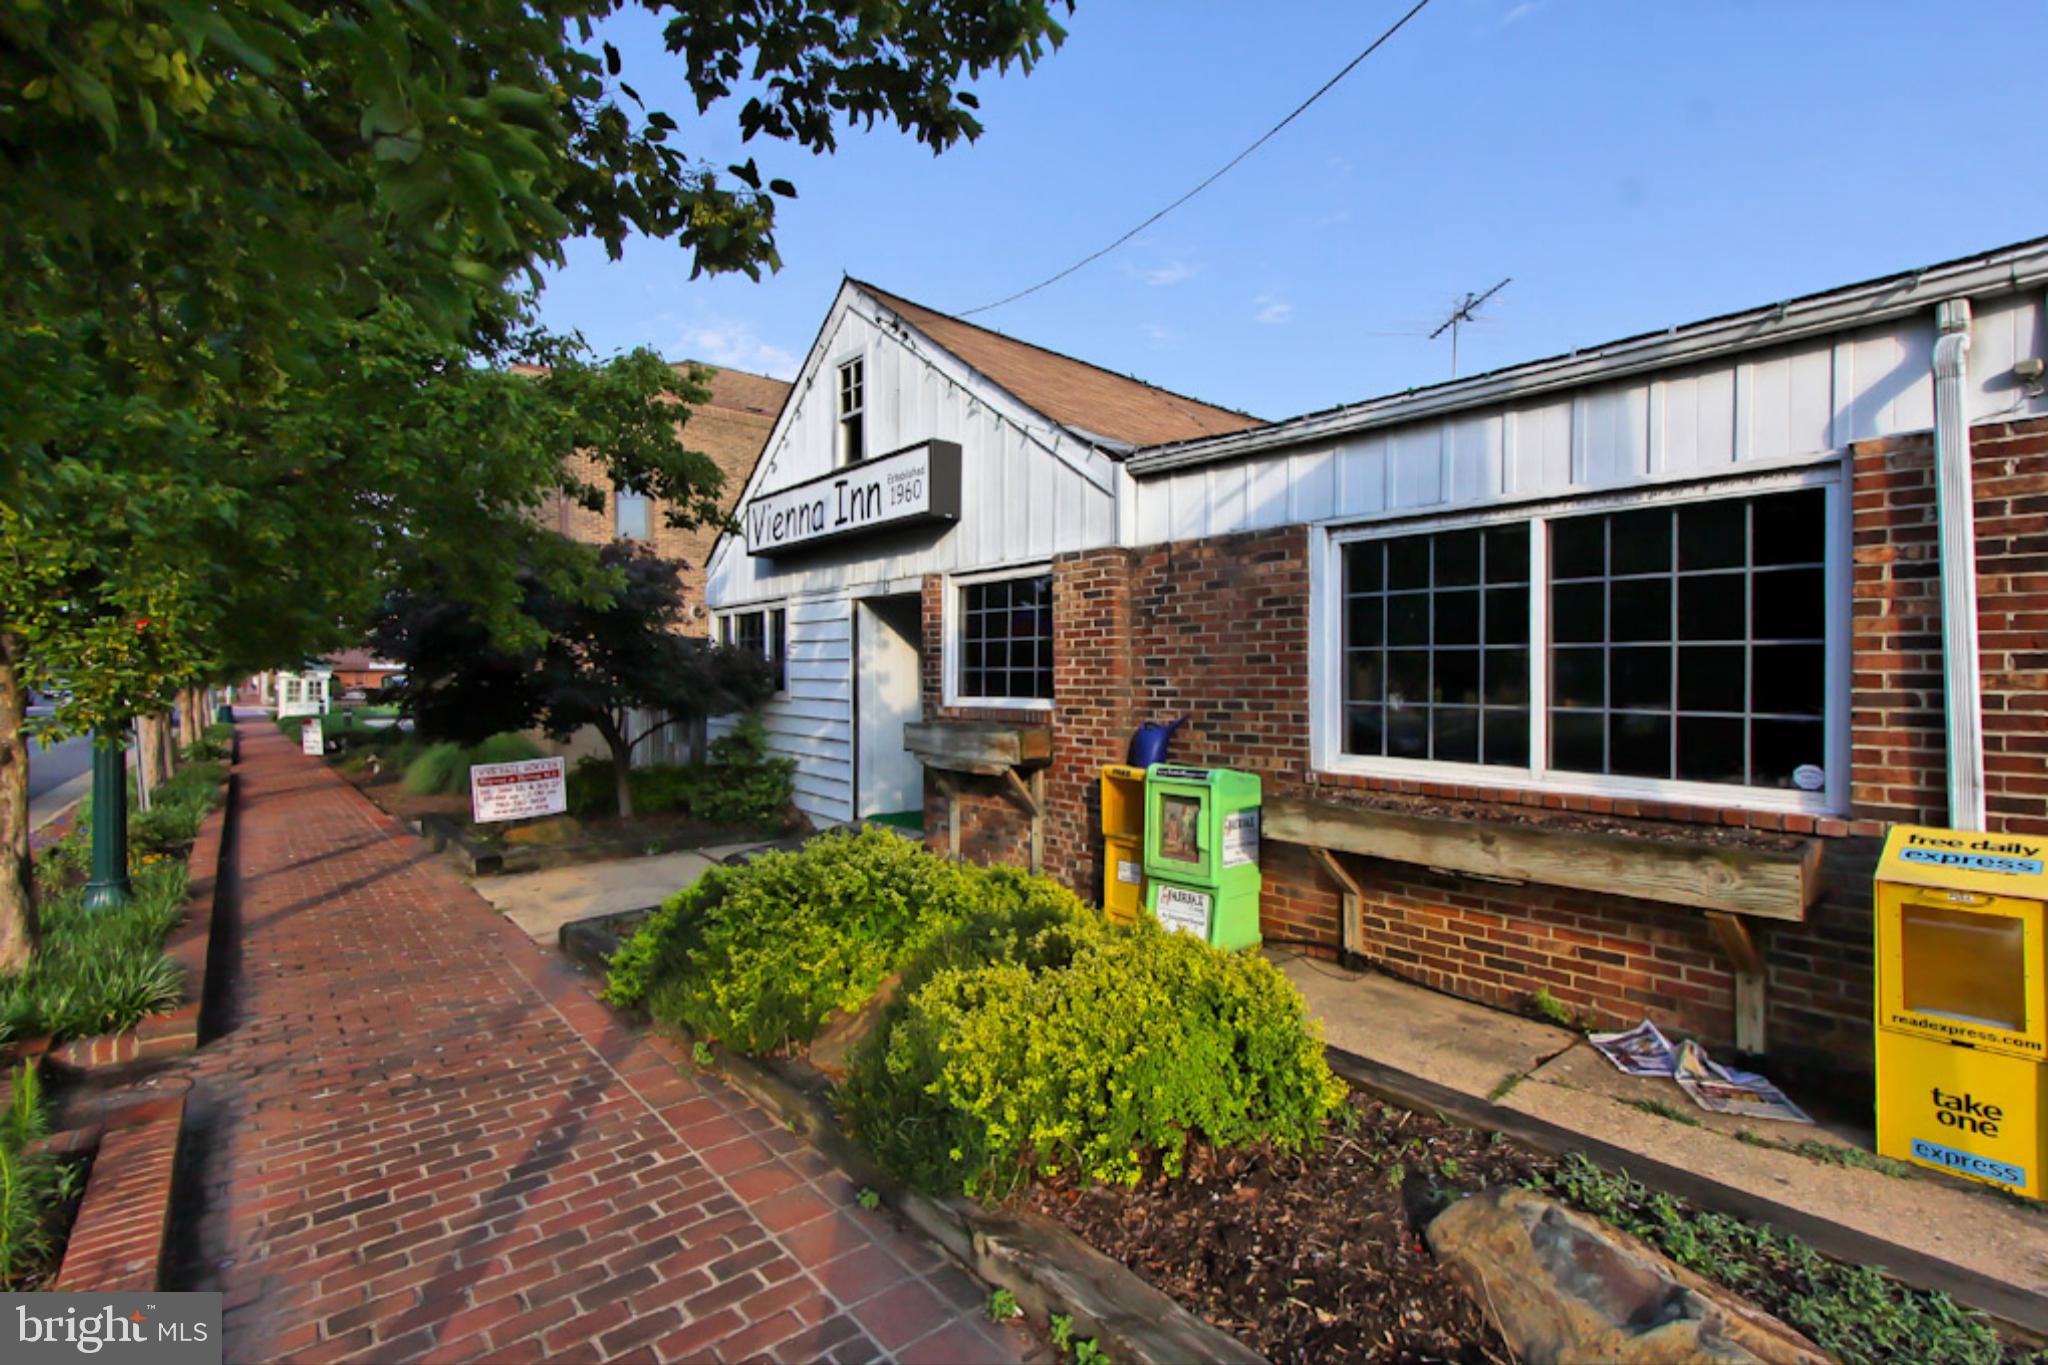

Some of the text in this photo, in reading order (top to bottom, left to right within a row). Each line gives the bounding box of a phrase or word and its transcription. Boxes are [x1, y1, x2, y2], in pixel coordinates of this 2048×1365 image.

[891, 479, 922, 506] 1960
[752, 479, 882, 546] Vienna Inn
[1905, 850, 2035, 872] express
[1909, 834, 2040, 857] free daily
[1892, 1014, 2042, 1050] readexpress.com
[1931, 1087, 2003, 1121] take
[1936, 1110, 1999, 1138] one
[1916, 1143, 2019, 1182] express
